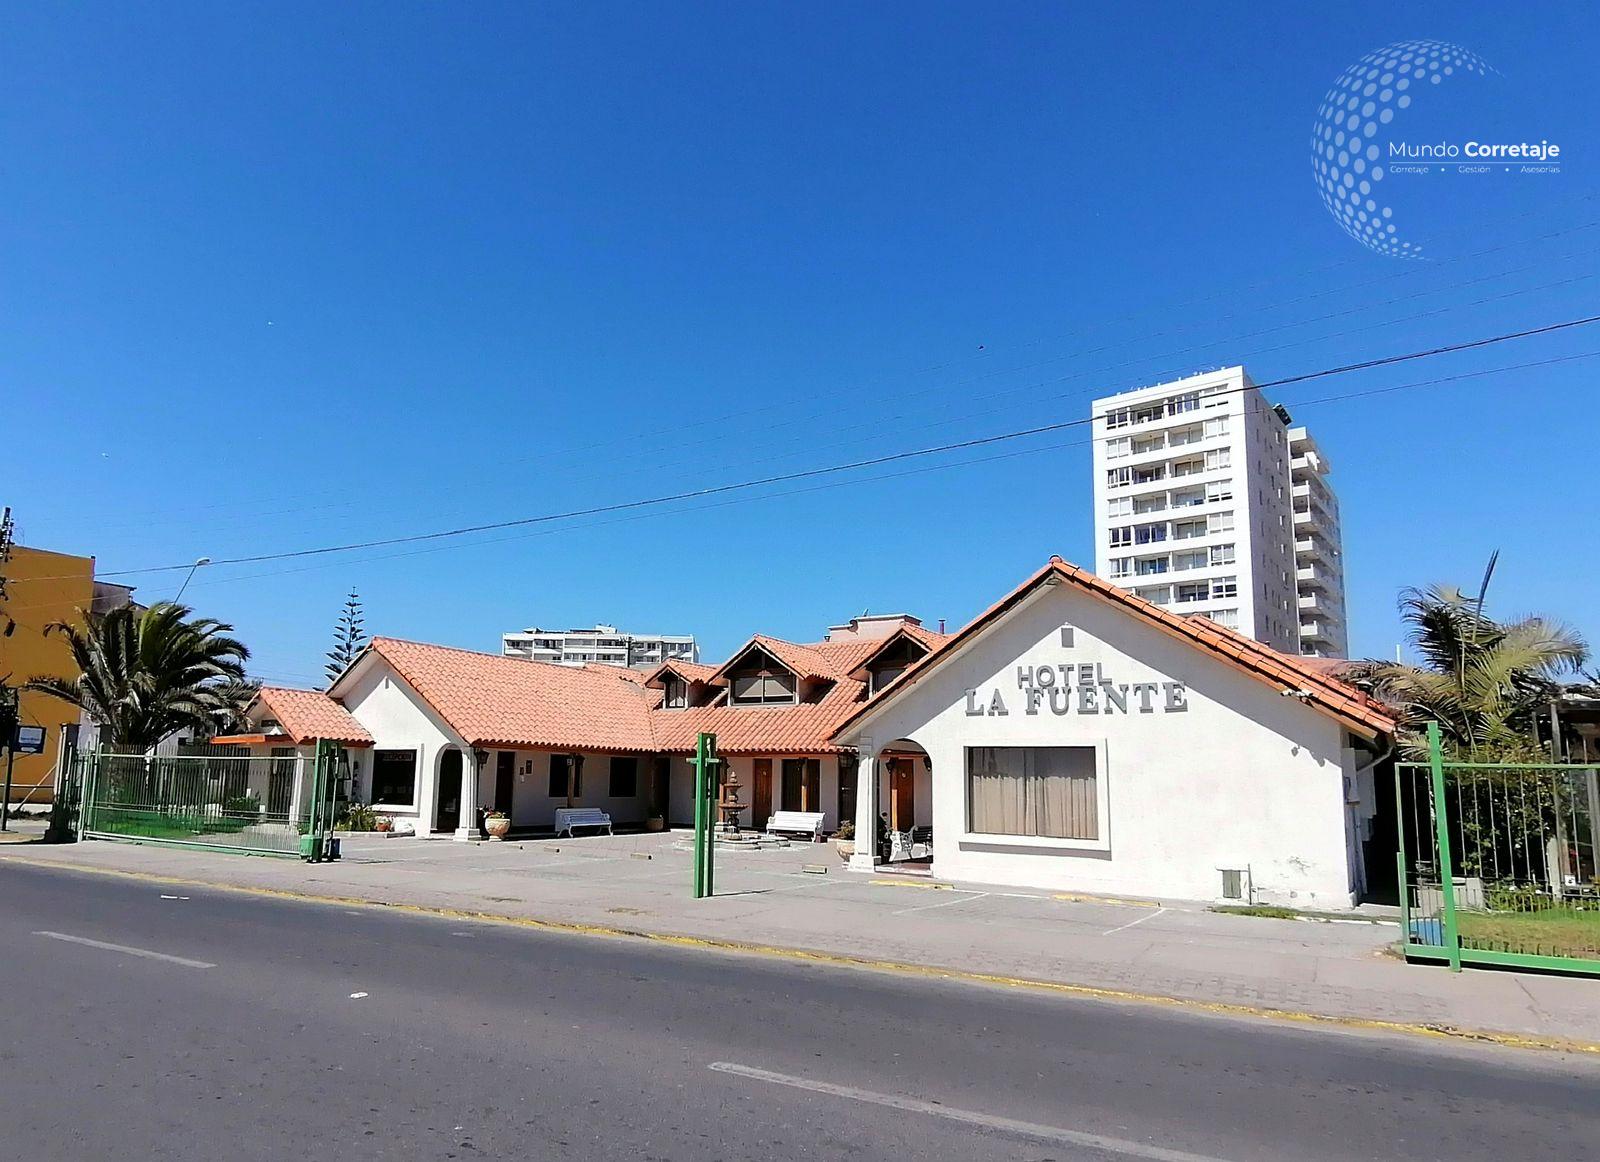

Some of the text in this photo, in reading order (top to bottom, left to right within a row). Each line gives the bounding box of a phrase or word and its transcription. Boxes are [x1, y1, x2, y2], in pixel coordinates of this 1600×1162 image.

[1017, 662, 1112, 689] HOTEL
[965, 681, 1188, 716] LA FUENTE
